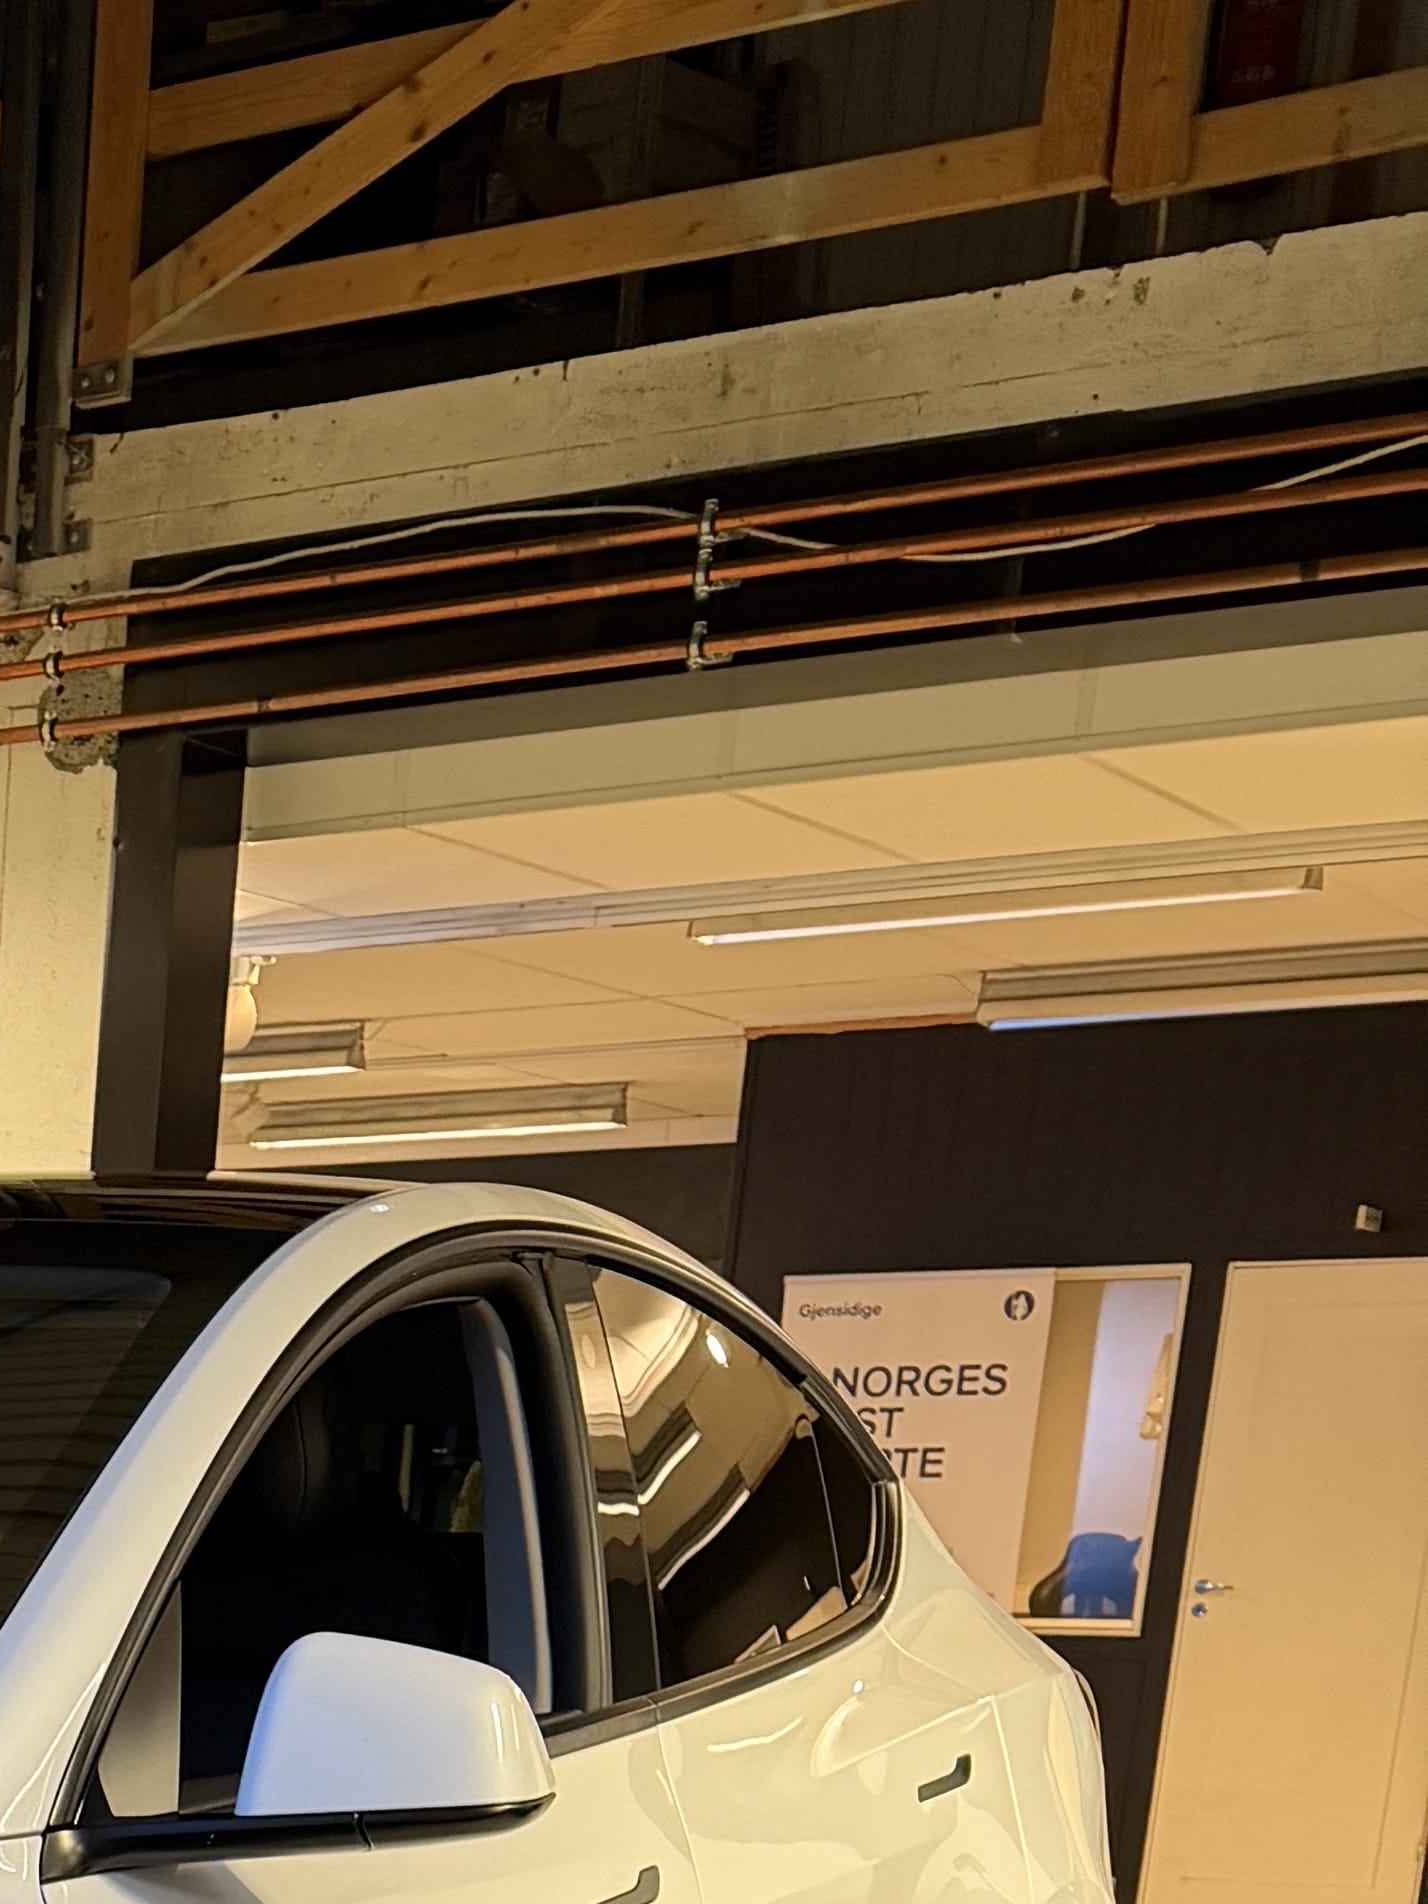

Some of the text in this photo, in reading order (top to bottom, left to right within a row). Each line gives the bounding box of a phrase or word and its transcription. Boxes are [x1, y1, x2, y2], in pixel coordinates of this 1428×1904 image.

[799, 1302, 882, 1320] Gjensidige
[833, 1364, 1008, 1397] NORGES
[857, 1407, 904, 1438] ST
